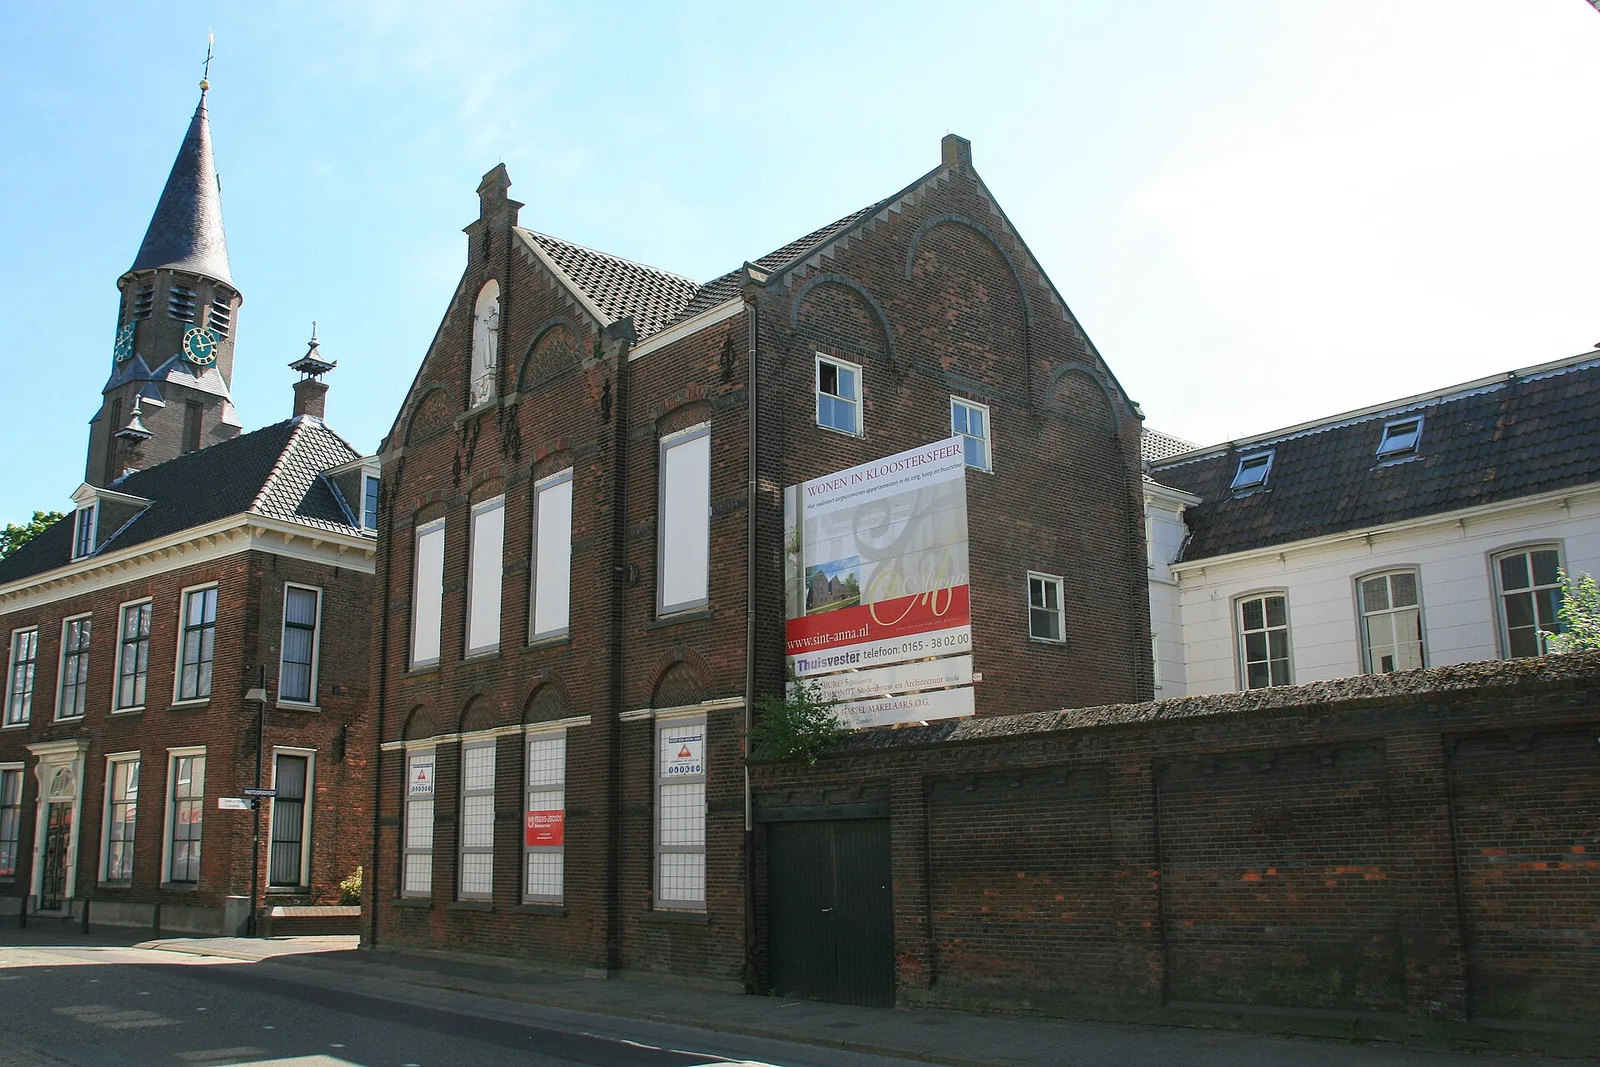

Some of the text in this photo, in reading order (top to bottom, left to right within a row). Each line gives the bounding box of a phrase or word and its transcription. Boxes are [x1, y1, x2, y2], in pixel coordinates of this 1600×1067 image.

[807, 444, 962, 497] WONEN IN KLOOSTERSFEER
[866, 480, 899, 494] appartementen
[922, 469, 933, 478] koop
[787, 623, 869, 650] www.sint-anna.nl
[797, 651, 861, 672] Thuisvester
[863, 645, 900, 659] telefoon:
[902, 641, 923, 653] 0165
[931, 638, 942, 649] 38
[944, 635, 955, 647] 02
[957, 633, 969, 644] 00
[856, 682, 893, 694] Stedenbouw
[904, 676, 944, 688] Architectuur
[867, 699, 913, 712] MAKELAARS
